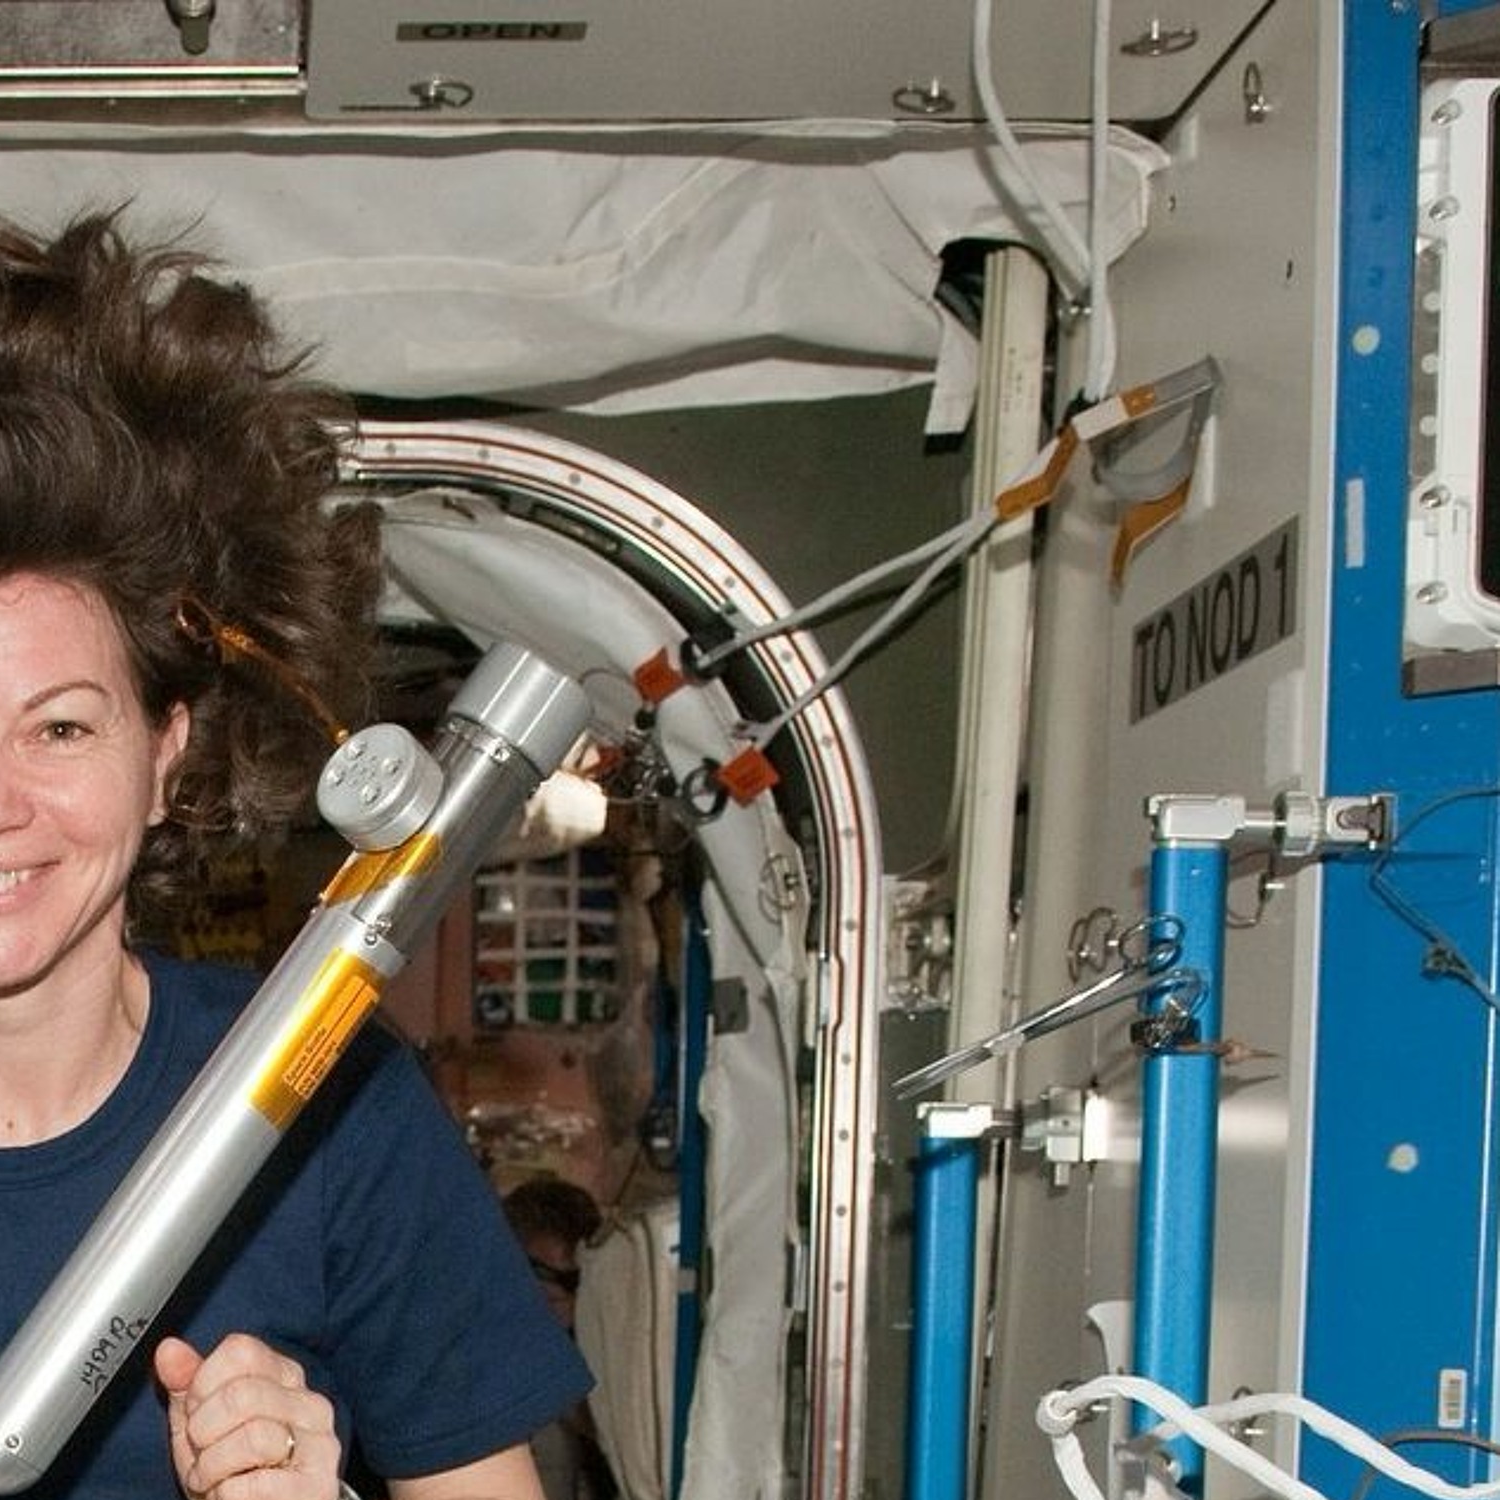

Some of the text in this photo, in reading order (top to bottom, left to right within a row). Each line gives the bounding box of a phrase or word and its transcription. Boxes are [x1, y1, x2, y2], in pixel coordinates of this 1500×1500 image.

[422, 22, 563, 39] OPEN
[1135, 533, 1288, 720] TO NOD 1
